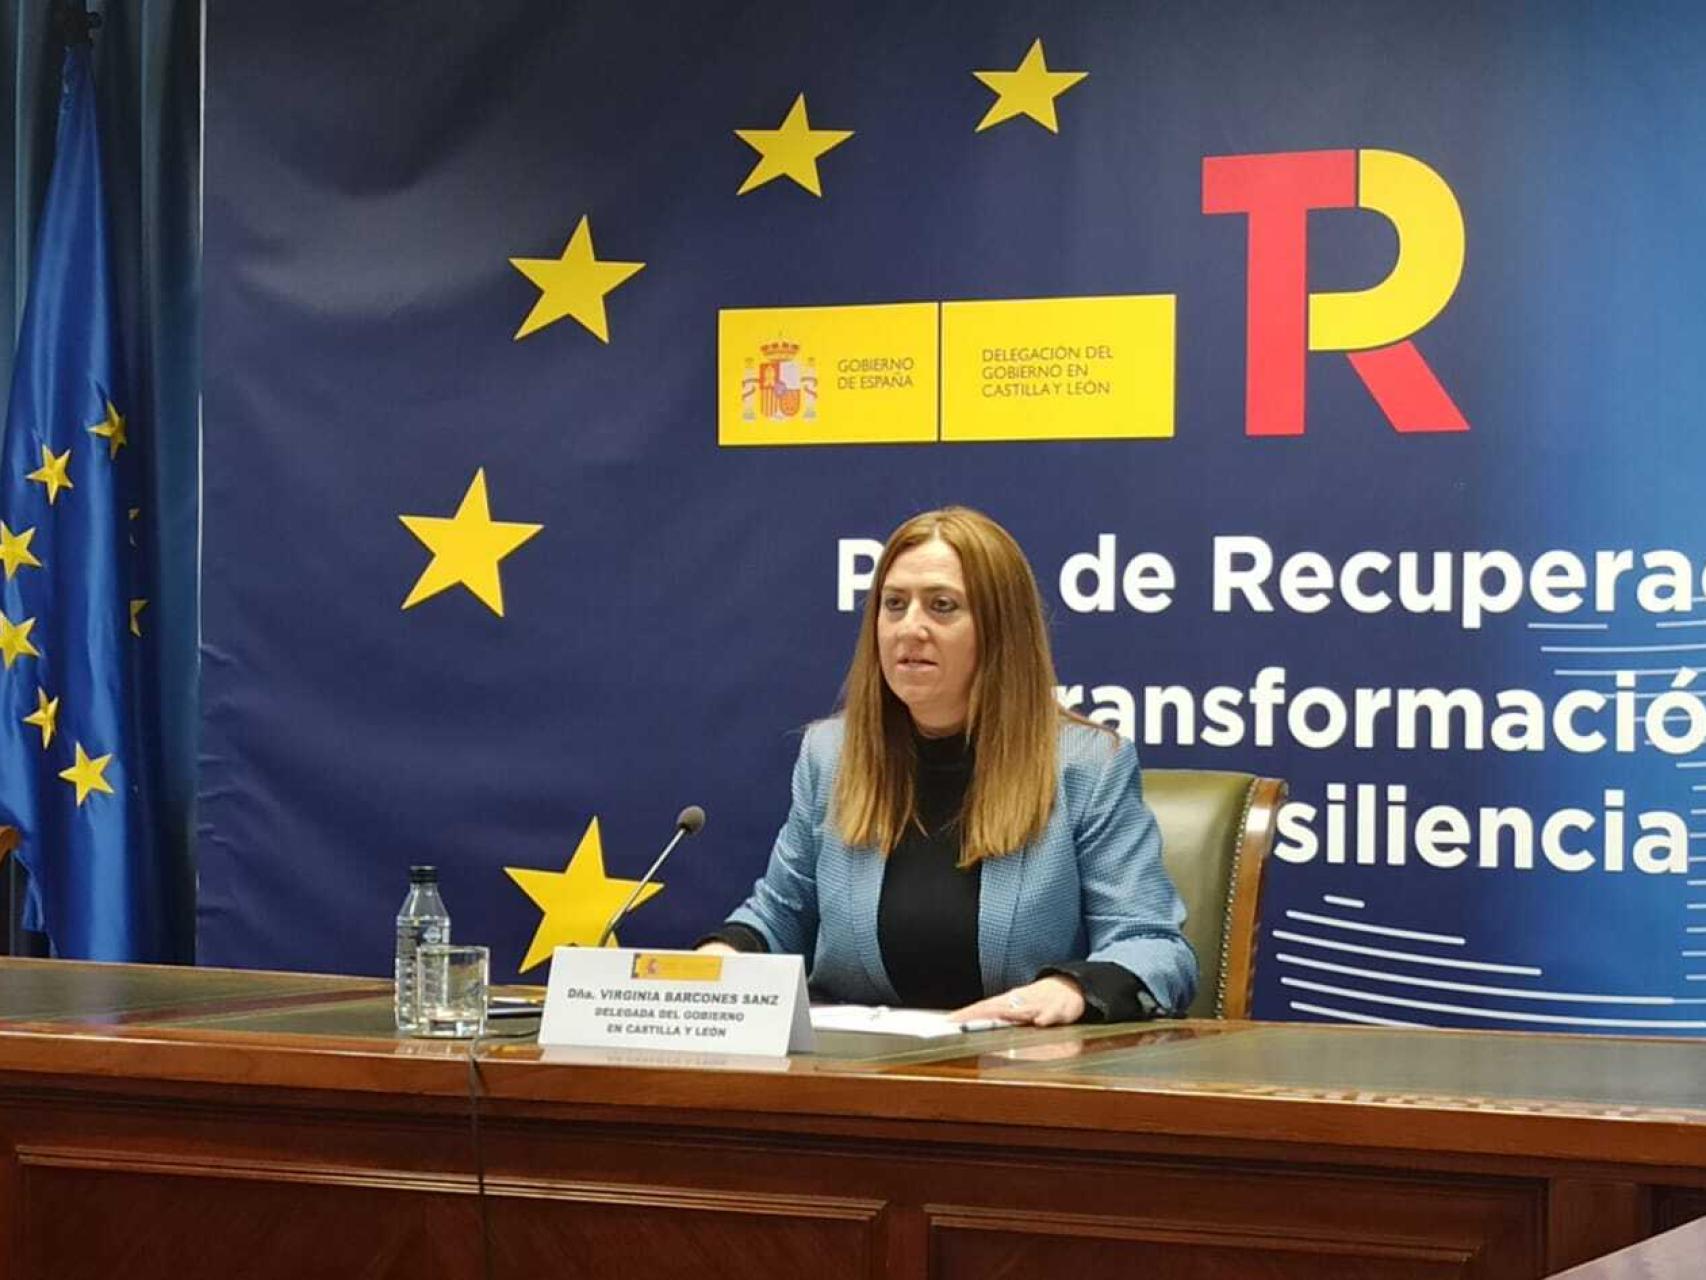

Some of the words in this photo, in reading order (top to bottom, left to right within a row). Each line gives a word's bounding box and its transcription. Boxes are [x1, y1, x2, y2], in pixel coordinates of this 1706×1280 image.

[1084, 344, 1114, 359] DEL
[837, 356, 915, 373] GOBIERNO
[982, 364, 1063, 380] GOBIERNO
[1067, 363, 1089, 377] EN
[837, 375, 857, 390] DE
[860, 371, 915, 389] ESPAÑA
[982, 383, 1050, 398] CASTILLA
[1052, 382, 1062, 395] Y
[1066, 379, 1111, 396] LEÓN
[1058, 533, 1177, 614] de
[1212, 535, 1706, 629] Recupera
[1273, 783, 1689, 874] siliencia
[600, 988, 661, 1001] VIRGINIA
[664, 991, 738, 1005] BARCONES
[741, 993, 780, 1007] SANZ
[594, 1007, 656, 1018] DELEGADA
[658, 1009, 681, 1020] DEL
[683, 1010, 745, 1023] GOBIERNO
[606, 1023, 623, 1034] EN
[625, 1023, 681, 1036] CASTILLA
[684, 1026, 693, 1036] Y
